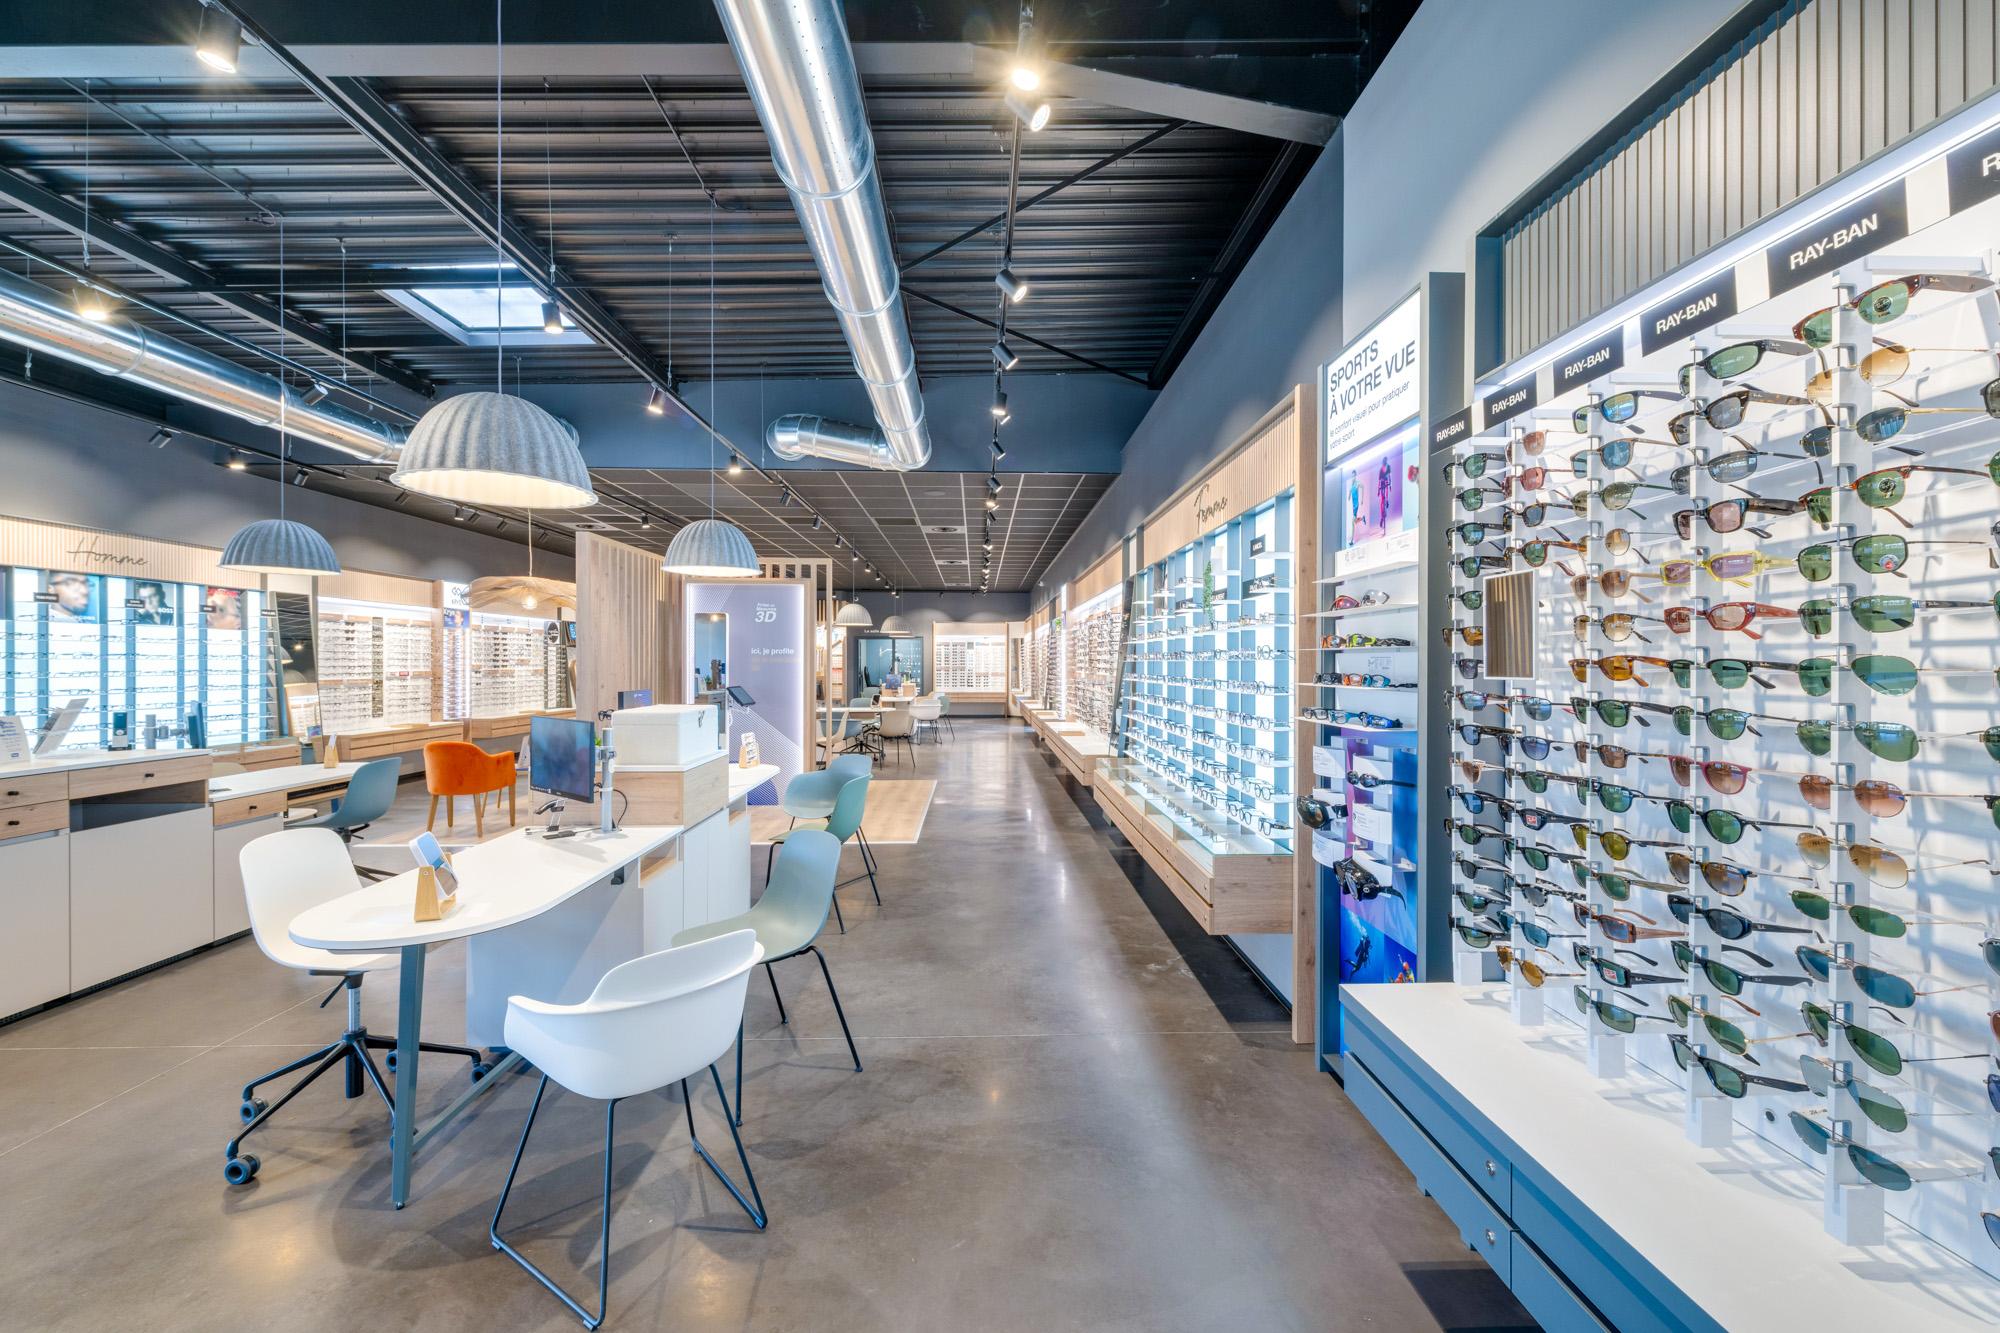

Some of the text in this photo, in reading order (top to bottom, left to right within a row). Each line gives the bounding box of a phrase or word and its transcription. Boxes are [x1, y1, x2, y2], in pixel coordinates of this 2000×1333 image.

[1790, 213, 1879, 271] RAY-BAN
[1656, 293, 1718, 335] RAY-BAN
[1330, 339, 1379, 393] SPORTS
[1340, 364, 1382, 411] VOTRE
[1385, 339, 1416, 379] VUE
[1564, 347, 1610, 379] RAY-BAN
[1368, 399, 1381, 415] pour
[1382, 380, 1411, 406] pratiquer
[1491, 389, 1527, 415] RAY-BAN
[1436, 420, 1465, 442] RAY-BAN
[66, 535, 150, 568] Homme
[755, 610, 777, 623] 3D
[763, 647, 770, 656] je
[770, 647, 795, 656] profite
